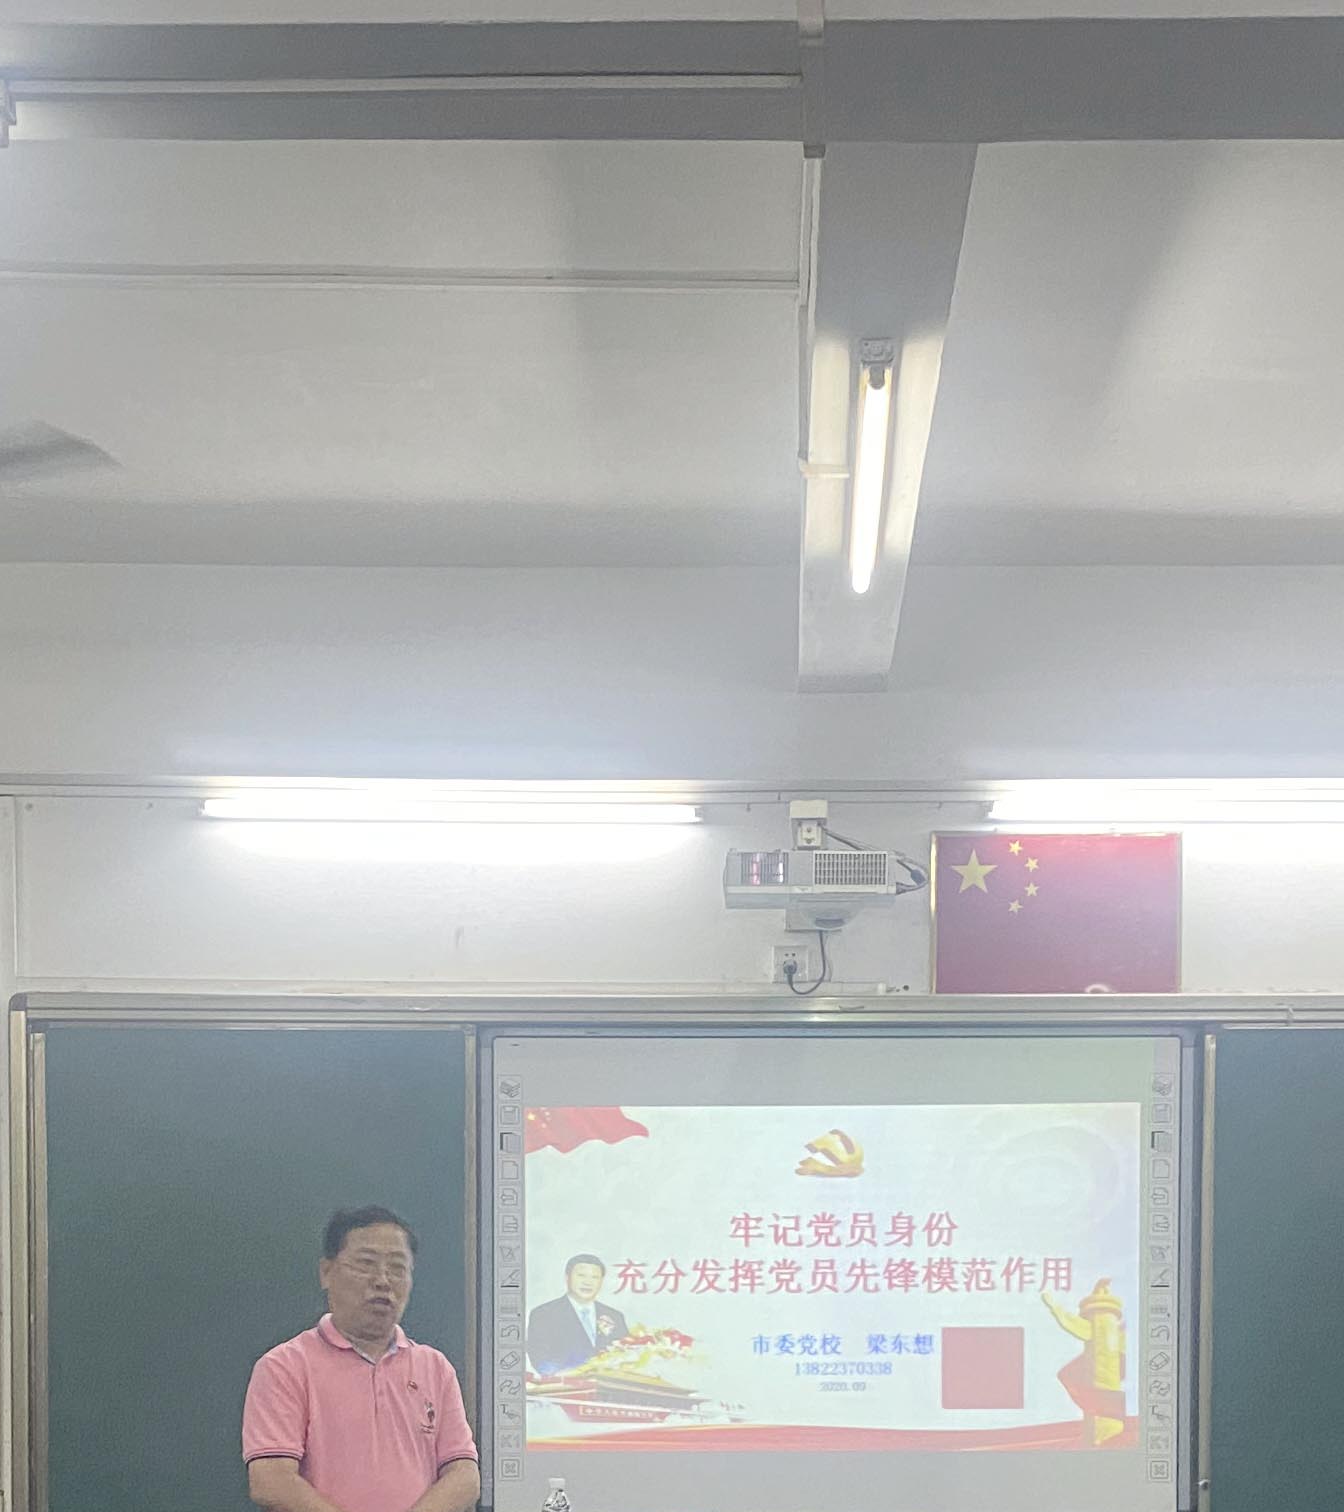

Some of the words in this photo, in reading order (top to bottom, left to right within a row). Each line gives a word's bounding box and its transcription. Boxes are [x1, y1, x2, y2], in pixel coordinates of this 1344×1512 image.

[728, 1211, 959, 1248] 牢记党员身份
[612, 1255, 1074, 1295] 充分发挥党员先锋模范作用
[751, 1333, 843, 1356] 市委党校
